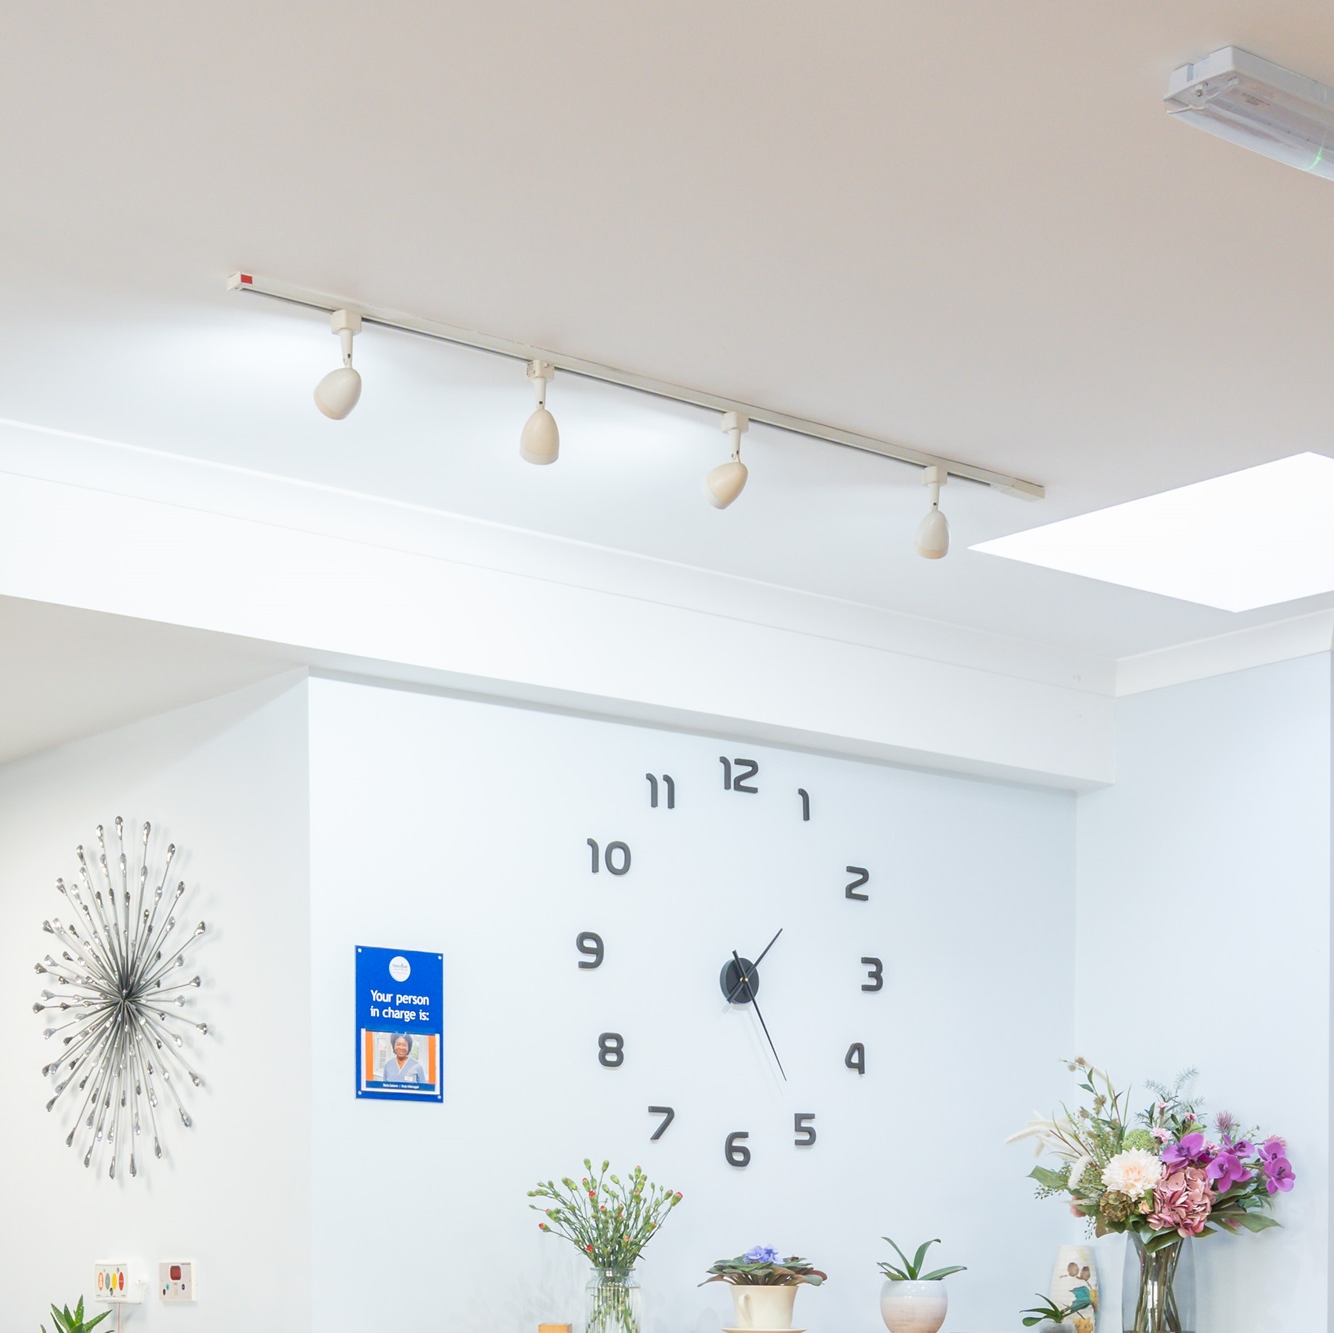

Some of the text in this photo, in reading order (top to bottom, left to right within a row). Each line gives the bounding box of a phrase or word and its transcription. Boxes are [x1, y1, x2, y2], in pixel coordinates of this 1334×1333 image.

[645, 773, 675, 810] 11
[719, 756, 759, 794] 12
[798, 788, 810, 822] 1
[587, 838, 631, 876] 10
[845, 865, 870, 902] 2
[576, 931, 604, 969] 9
[860, 956, 884, 992] 3
[370, 989, 429, 1006] Your person
[370, 1005, 429, 1022] in charge is:
[598, 1032, 624, 1068] 8
[844, 1042, 866, 1075] 4
[648, 1106, 675, 1141] 7
[794, 1113, 817, 1146] 5
[724, 1131, 751, 1168] 6
